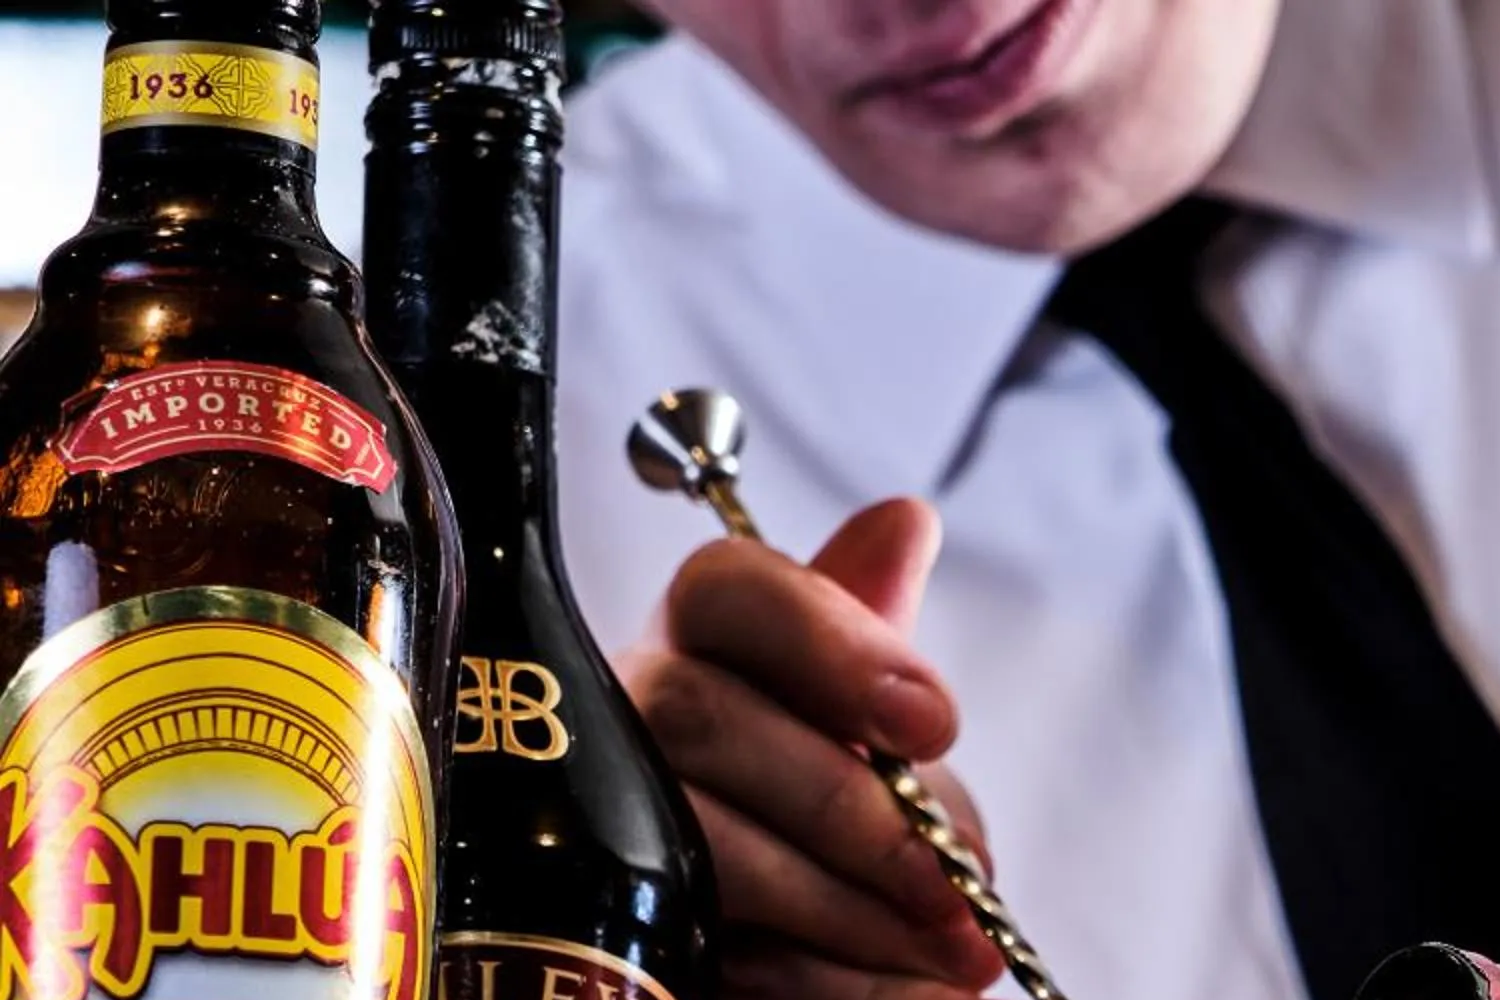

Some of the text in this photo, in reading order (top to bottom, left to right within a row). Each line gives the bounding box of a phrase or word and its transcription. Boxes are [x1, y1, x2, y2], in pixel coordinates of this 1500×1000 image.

[130, 73, 214, 100] 1936
[100, 393, 352, 450] IMPORTED
[197, 418, 262, 434] 1936
